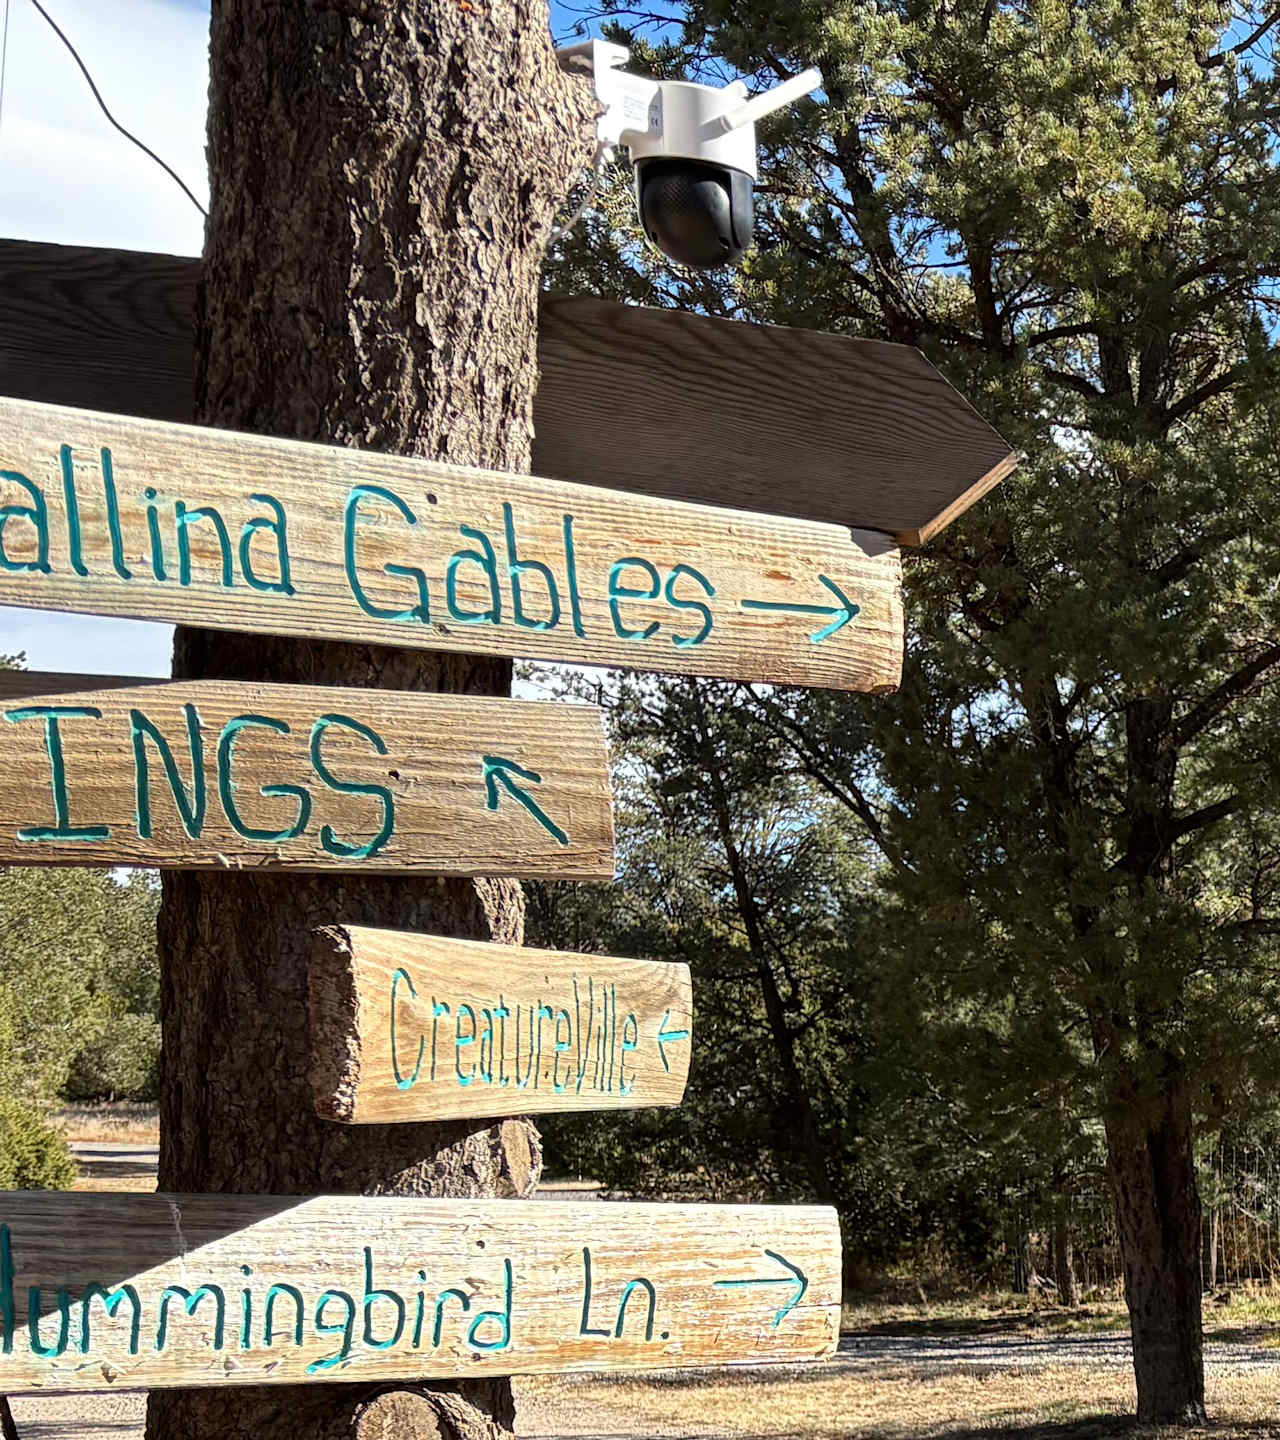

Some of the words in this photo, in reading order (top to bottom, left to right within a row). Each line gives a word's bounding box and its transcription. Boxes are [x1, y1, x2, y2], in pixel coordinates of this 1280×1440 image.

[345, 483, 716, 647] Gables
[4, 702, 395, 859] INGS
[580, 1246, 670, 1341] Ln.
